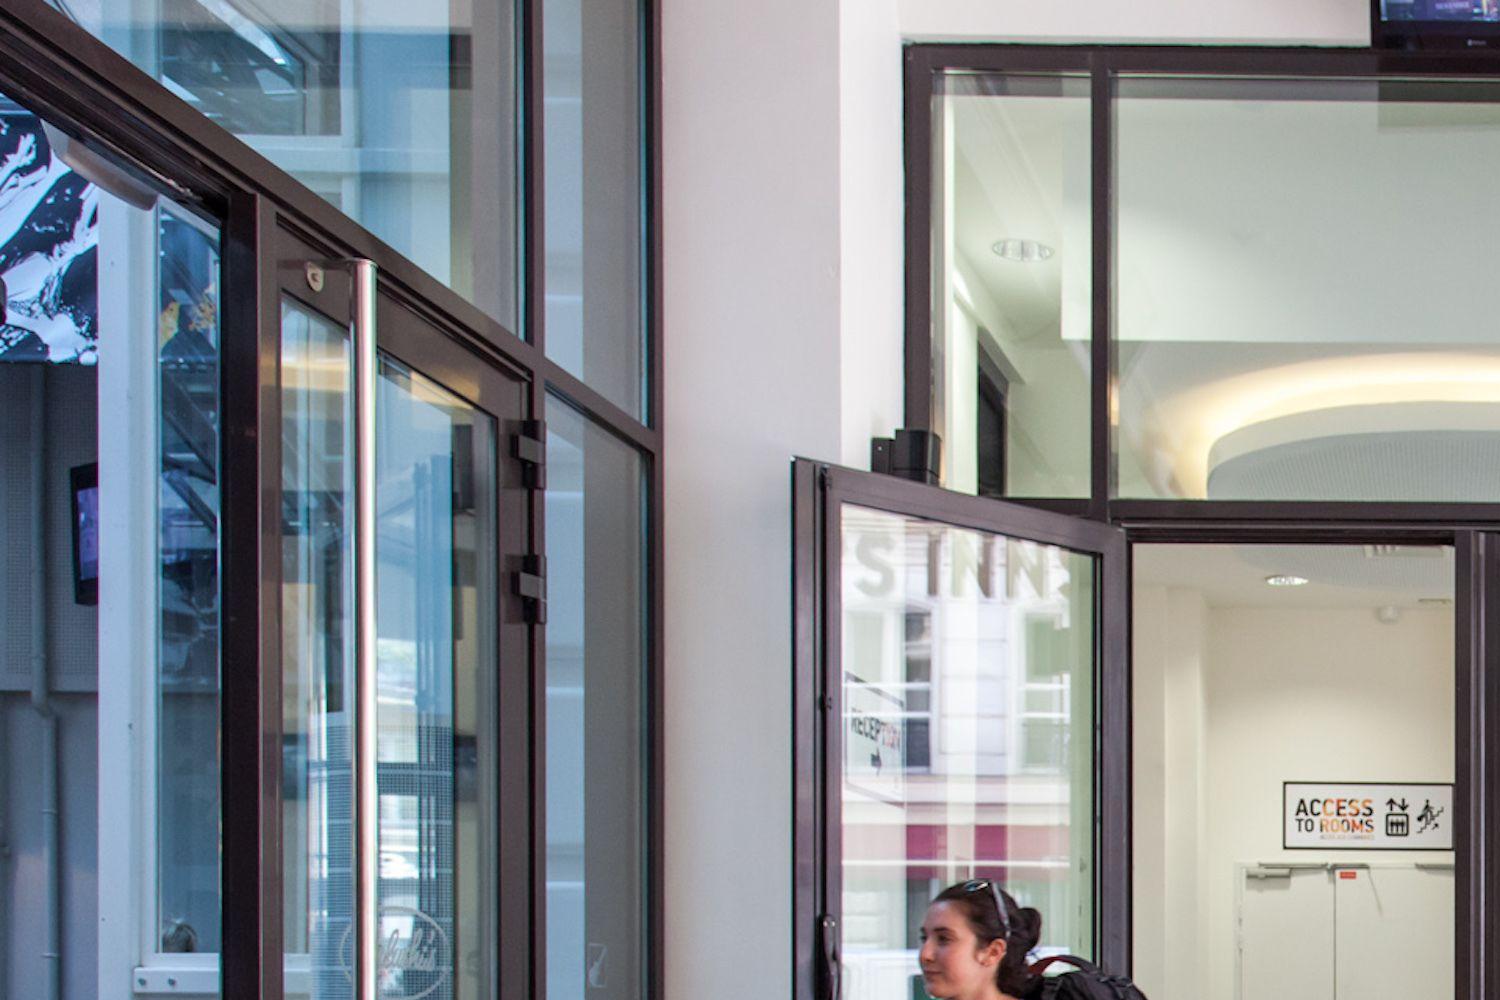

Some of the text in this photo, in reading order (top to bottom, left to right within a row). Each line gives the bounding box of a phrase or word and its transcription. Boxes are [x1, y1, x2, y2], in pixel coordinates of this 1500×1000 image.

[1295, 798, 1374, 817] ACCESS
[1295, 818, 1375, 833] TO ROOMS
